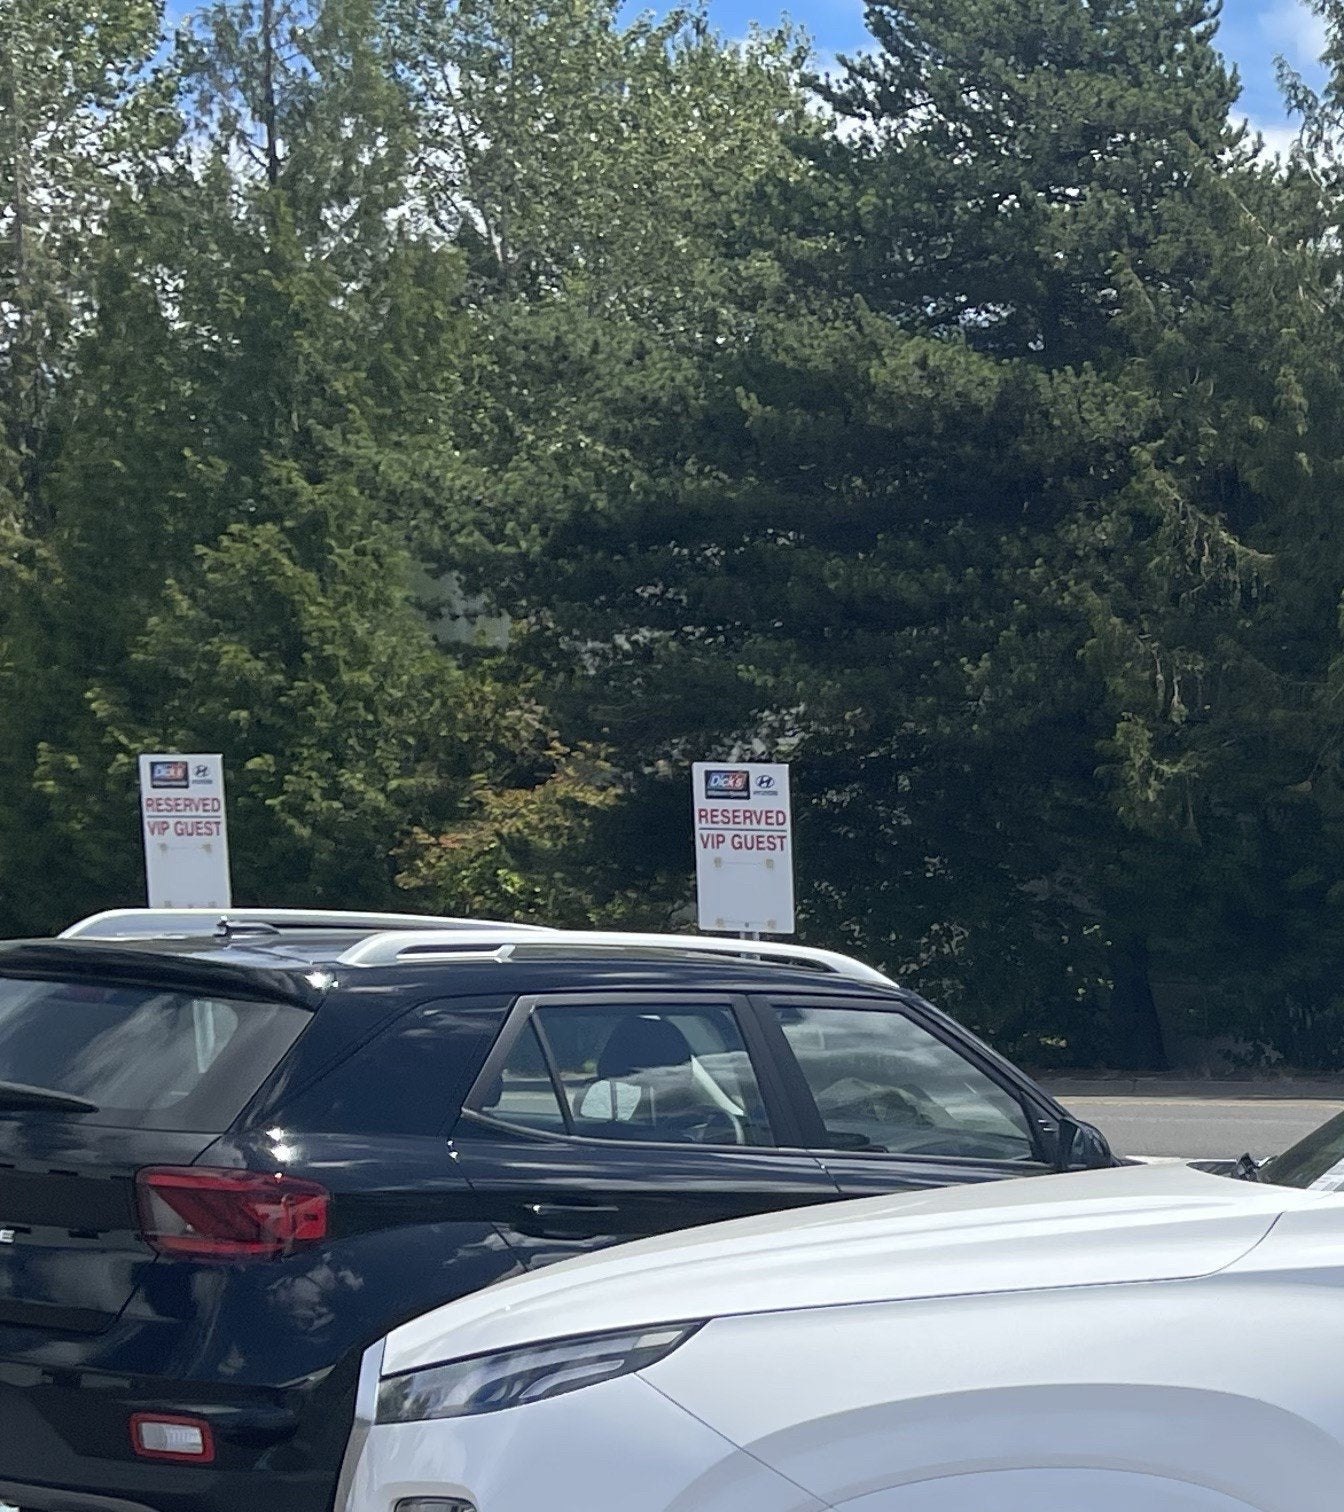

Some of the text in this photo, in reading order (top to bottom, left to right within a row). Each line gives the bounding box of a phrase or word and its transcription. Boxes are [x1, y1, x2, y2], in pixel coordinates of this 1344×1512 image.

[145, 797, 221, 813] RESERVED
[698, 808, 787, 826] RESERVED
[146, 821, 221, 837] VIP GUEST
[700, 833, 787, 851] VIP GUEST
